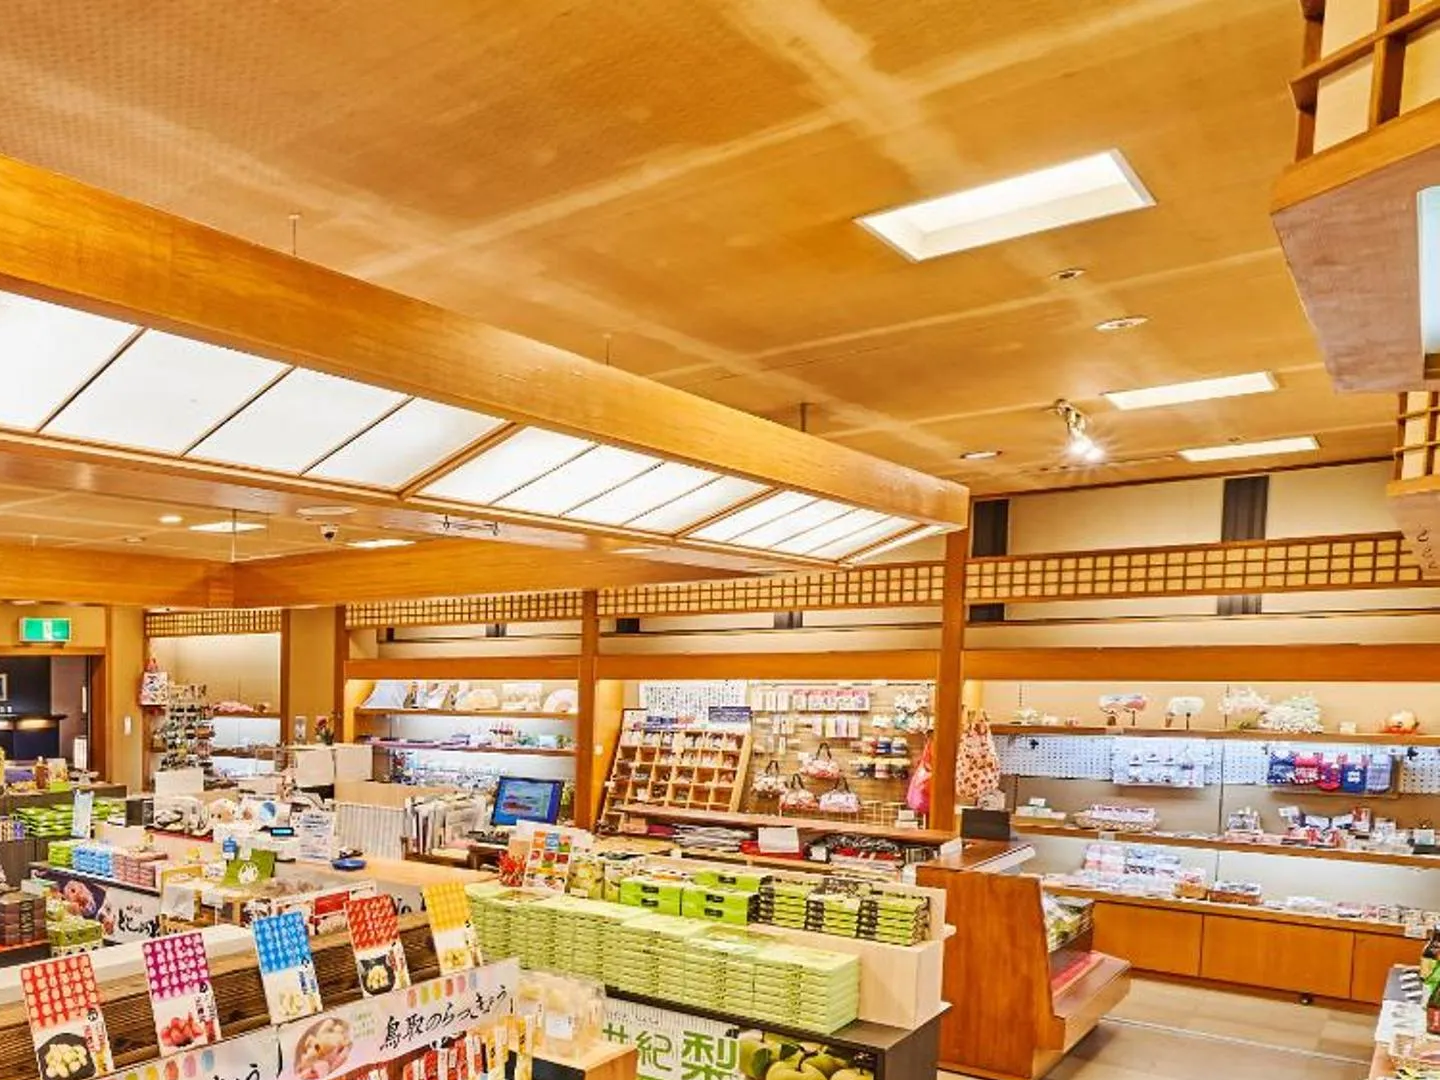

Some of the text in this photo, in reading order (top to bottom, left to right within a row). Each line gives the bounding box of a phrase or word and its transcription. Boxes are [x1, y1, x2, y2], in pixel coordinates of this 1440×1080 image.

[380, 984, 508, 1051] 鳥取のらっきょう
